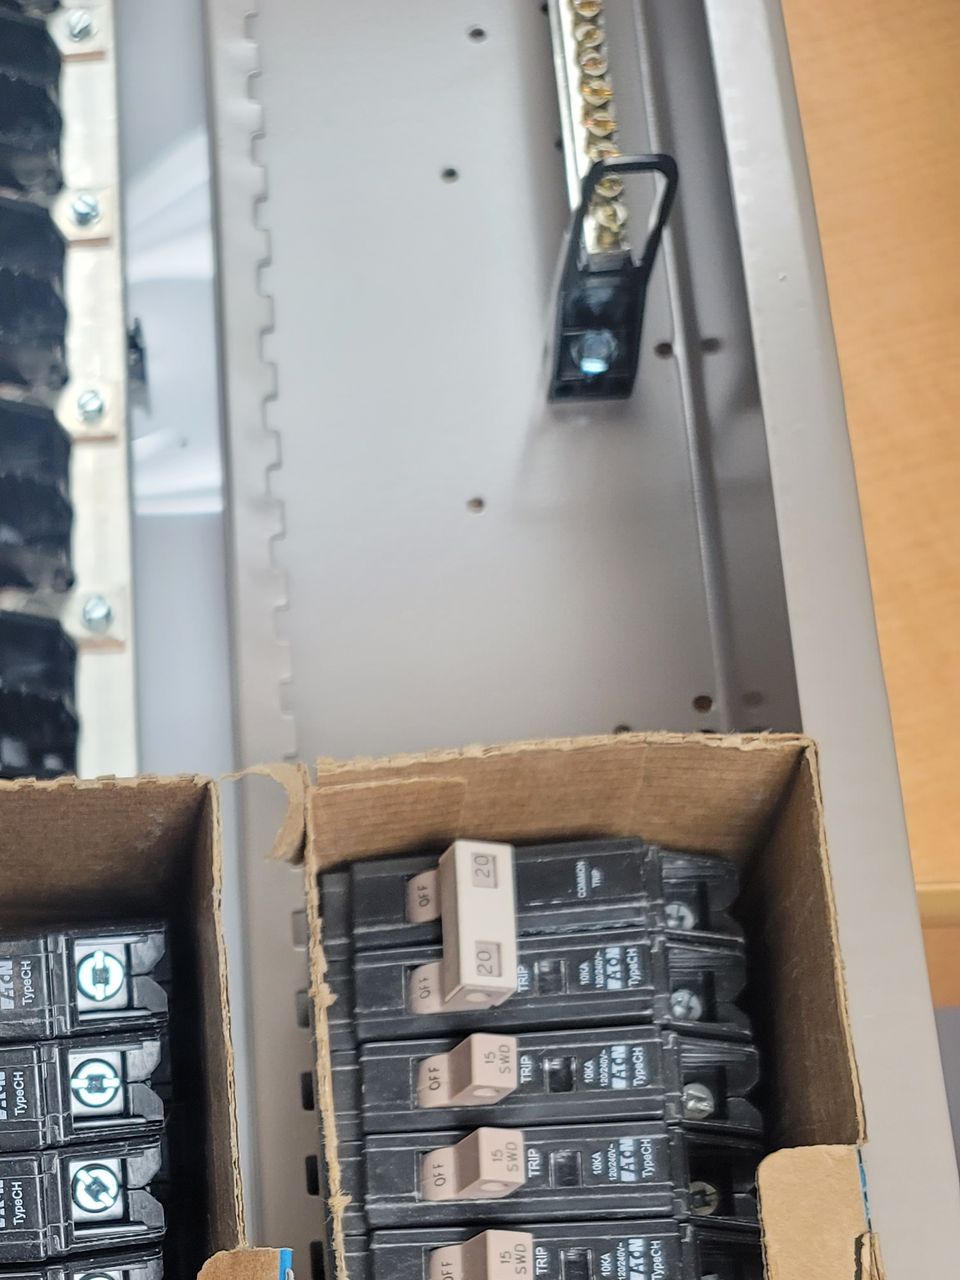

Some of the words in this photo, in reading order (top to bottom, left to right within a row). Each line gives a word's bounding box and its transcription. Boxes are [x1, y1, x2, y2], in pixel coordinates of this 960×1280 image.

[474, 855, 490, 878] 20
[591, 868, 600, 887] TRIP
[577, 861, 586, 898] COMMON
[418, 885, 430, 908] OFF
[476, 951, 493, 974] 20
[580, 962, 589, 984] 10KA
[418, 976, 430, 1000] OFF
[518, 966, 527, 993] TRIP
[484, 1050, 495, 1065] 15
[498, 1044, 511, 1074] SWD
[521, 1055, 532, 1084] TRIP
[428, 1066, 439, 1091] OFF
[583, 1060, 594, 1083] 10KA
[492, 1148, 503, 1164] 15
[507, 1142, 519, 1172] SWD
[528, 1149, 538, 1178] TRIP
[592, 1152, 602, 1175] 10KA
[434, 1162, 445, 1188] OFF
[500, 1250, 511, 1265] 15
[515, 1244, 527, 1275] SWD
[536, 1247, 546, 1275] TRIP
[602, 1252, 611, 1276] 10KA
